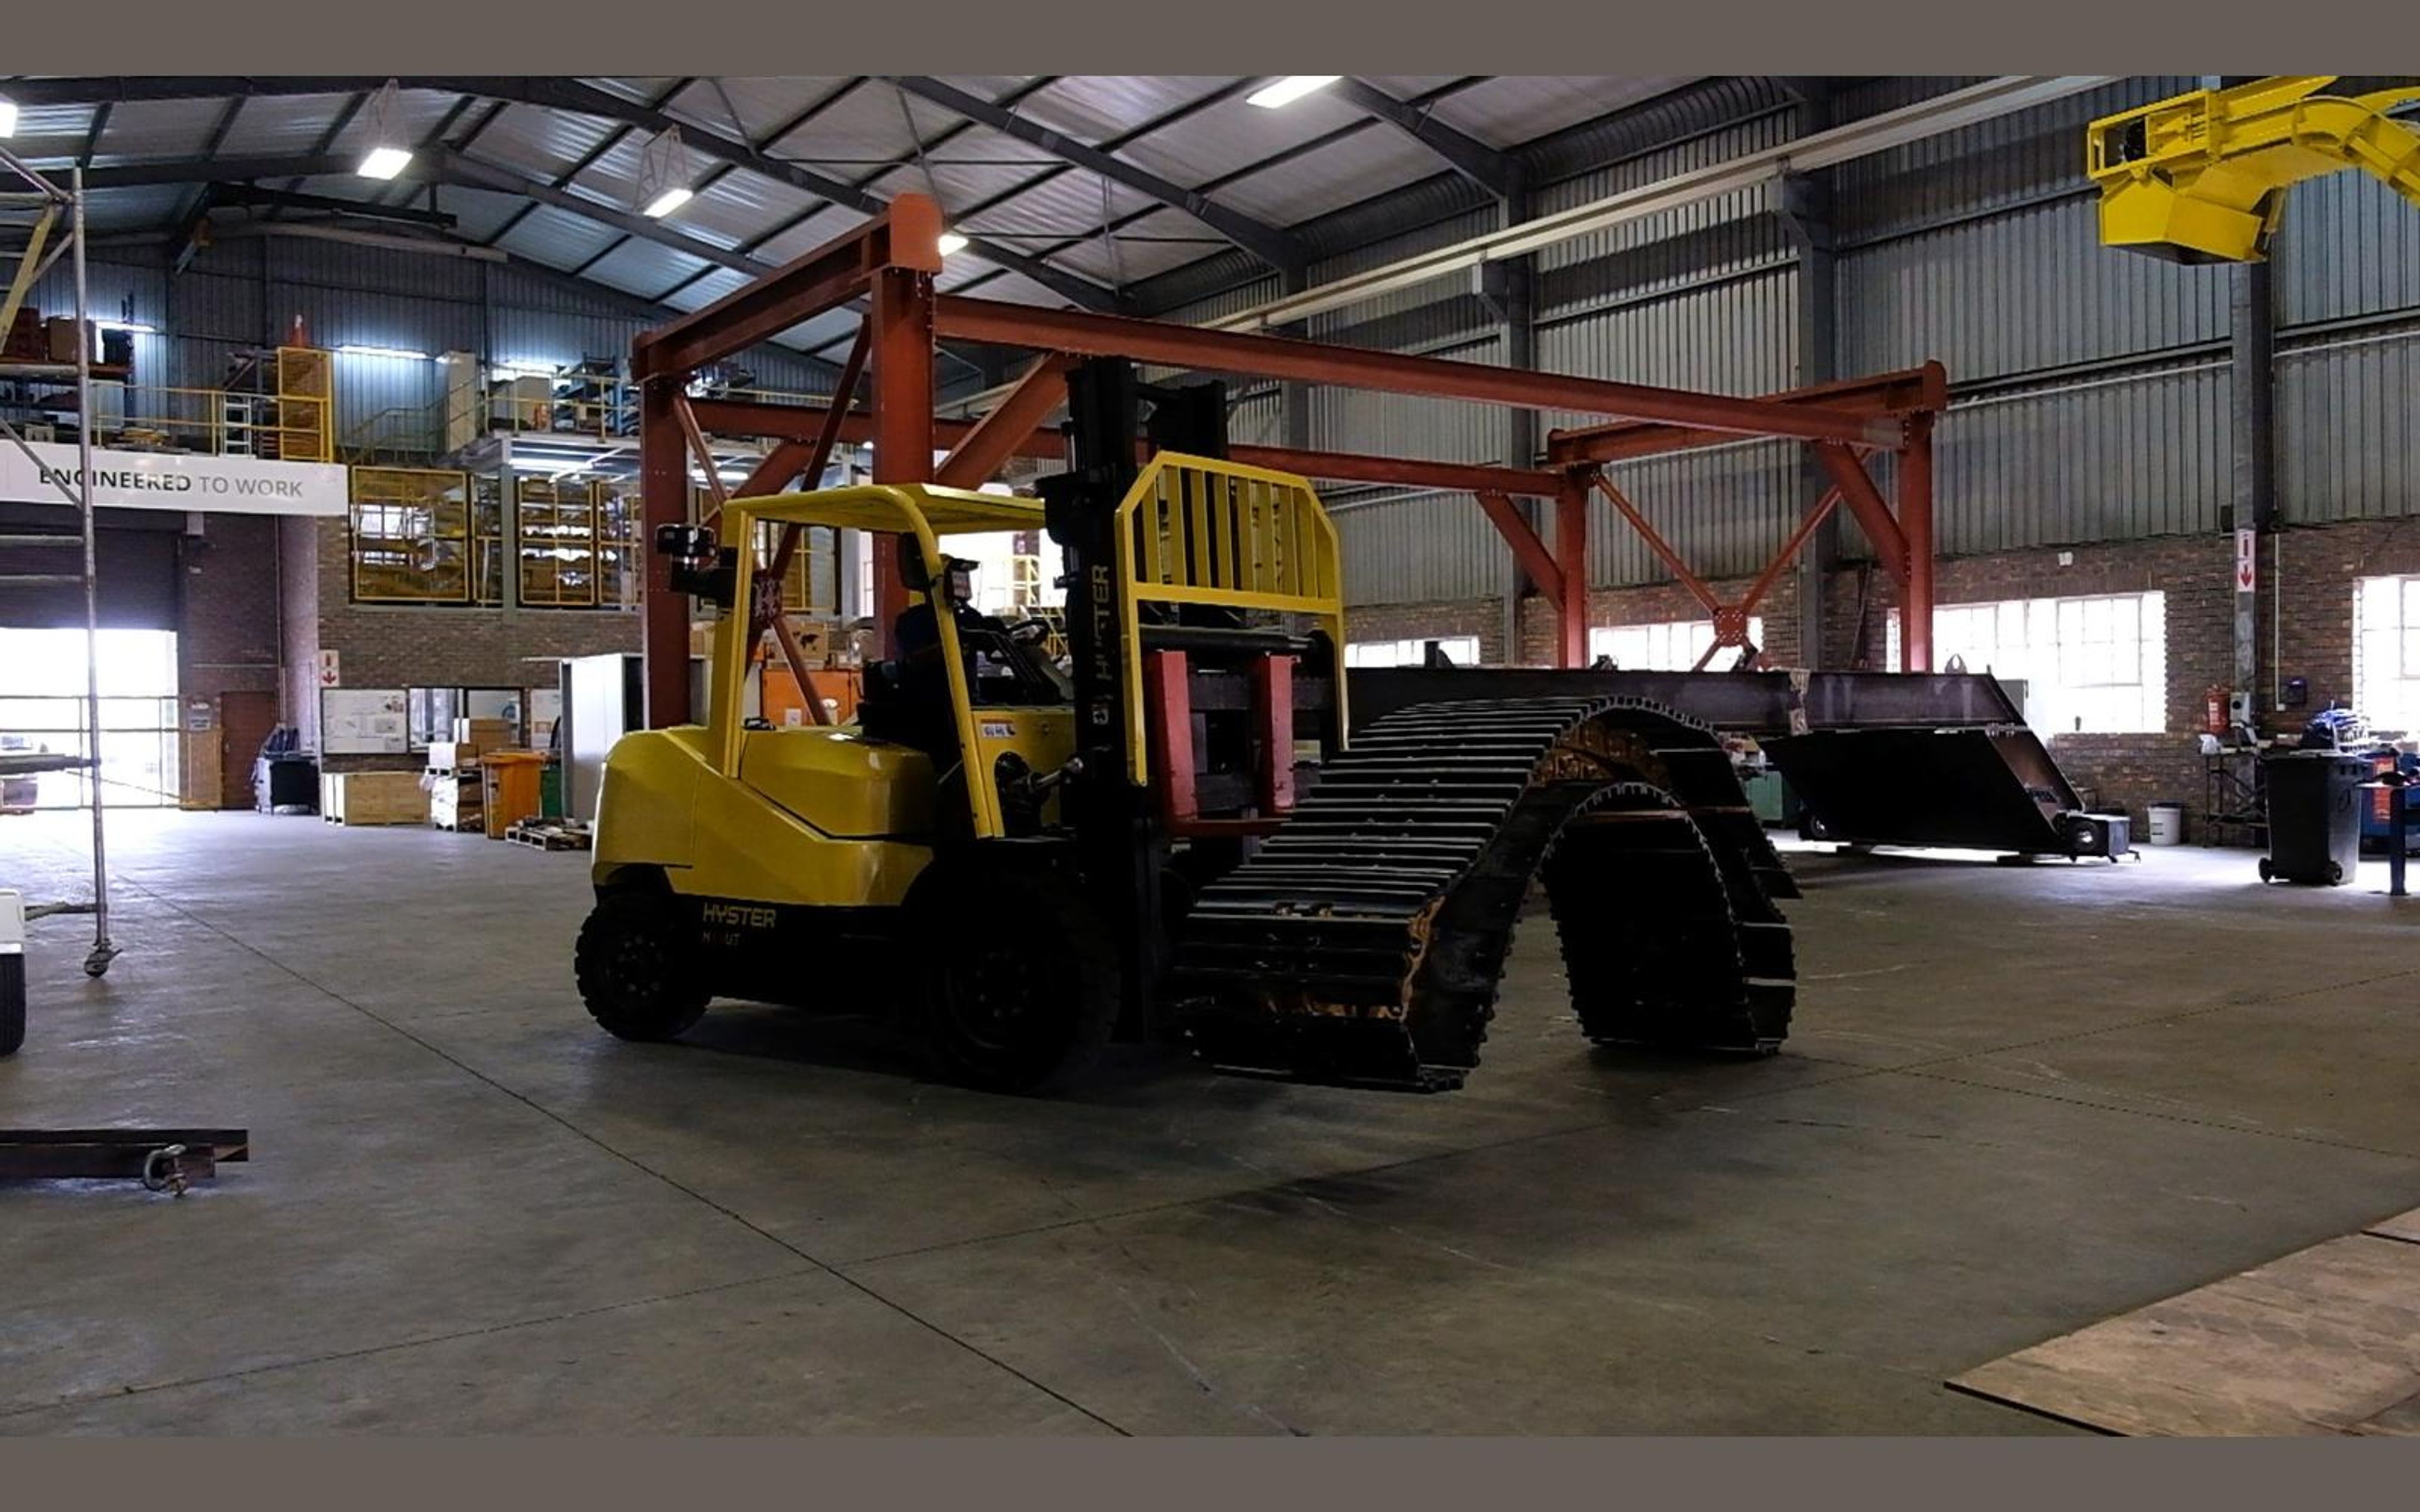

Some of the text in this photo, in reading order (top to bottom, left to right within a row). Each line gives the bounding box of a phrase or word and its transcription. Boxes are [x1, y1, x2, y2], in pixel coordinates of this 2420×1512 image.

[199, 476, 229, 494] TO
[235, 478, 303, 498] WORK
[702, 901, 776, 929] HYSTER
